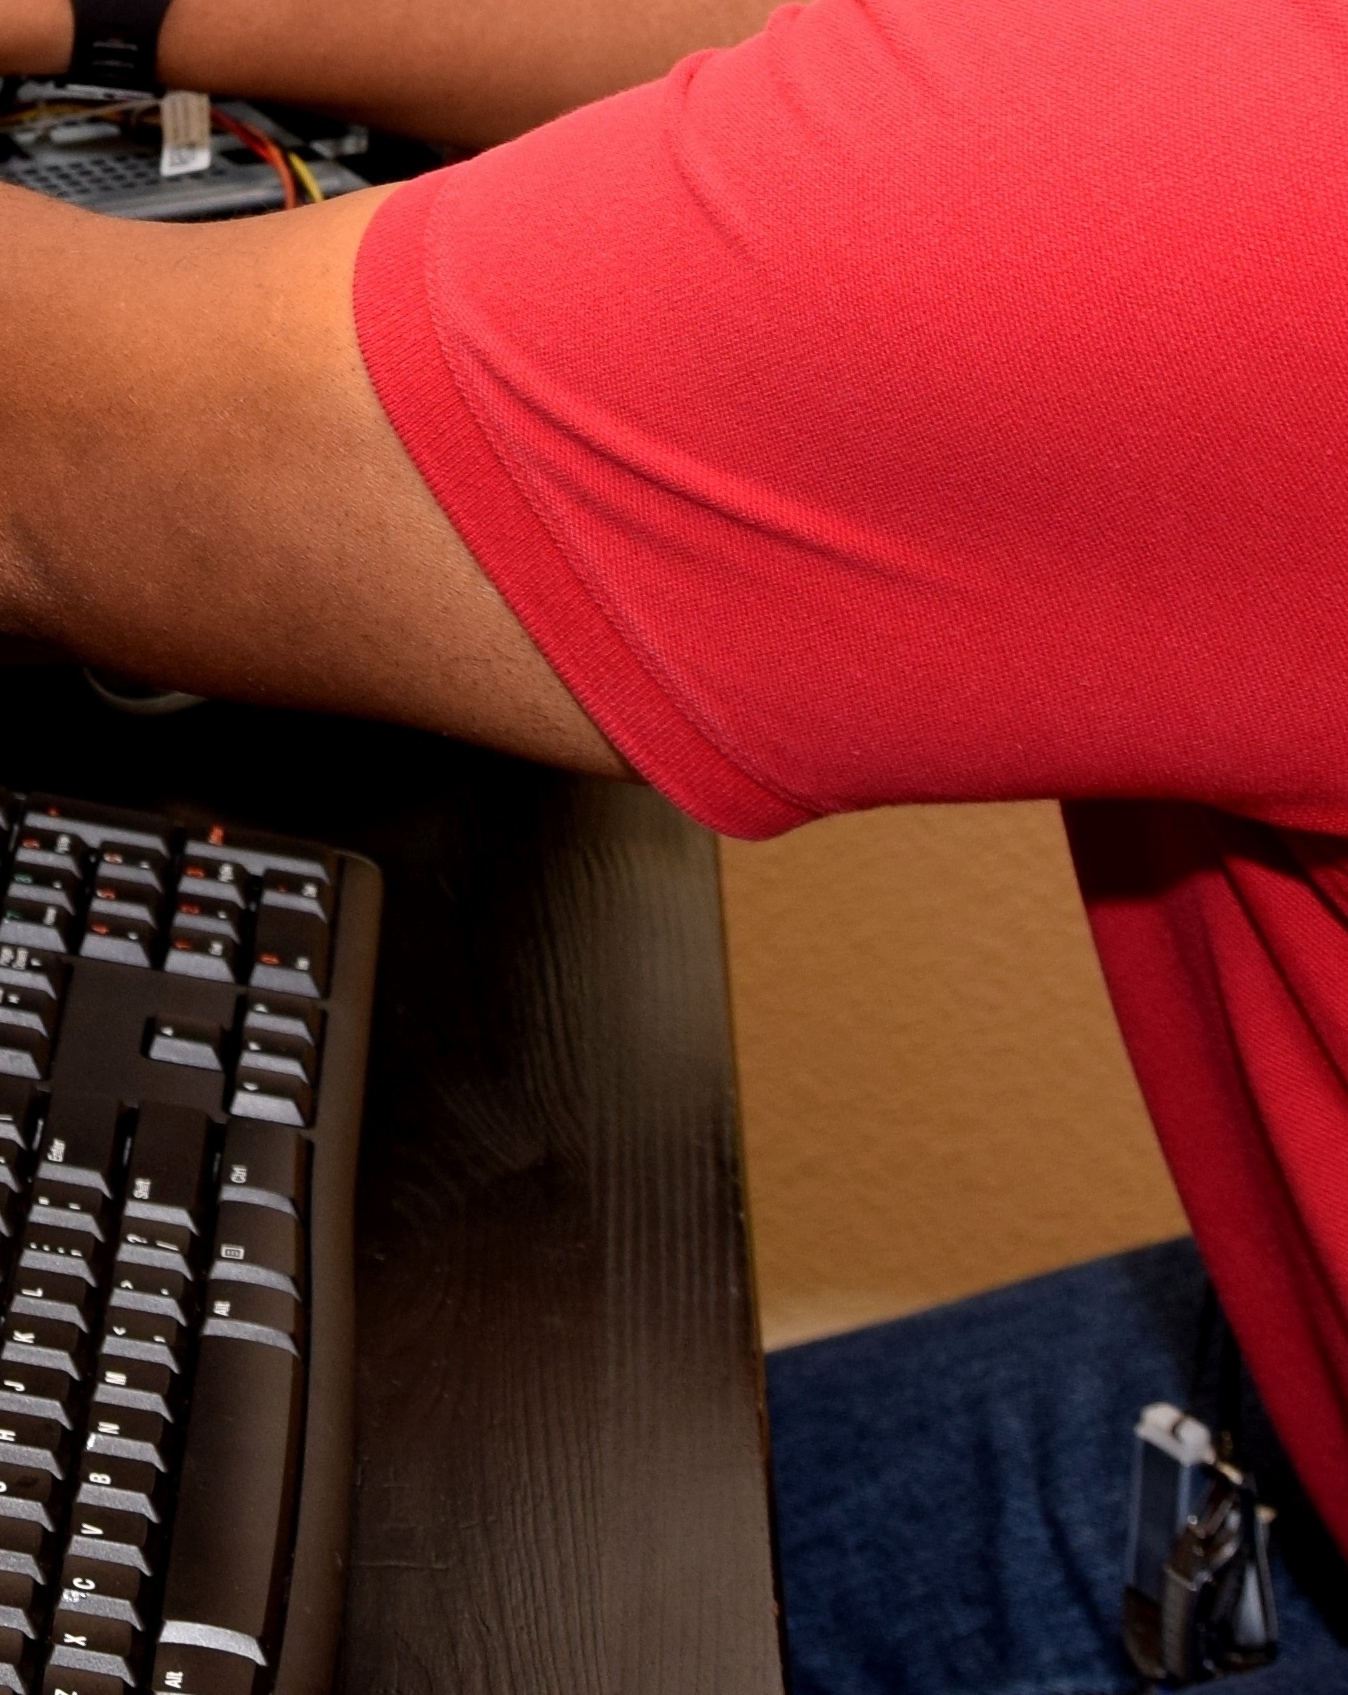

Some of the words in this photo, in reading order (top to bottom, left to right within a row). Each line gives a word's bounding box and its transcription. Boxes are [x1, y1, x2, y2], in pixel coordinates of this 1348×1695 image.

[48, 1139, 65, 1162] Enter
[231, 1166, 246, 1183] Ctrl
[134, 1179, 151, 1199] Shift
[22, 1288, 43, 1297] L
[214, 1301, 230, 1315] Alt
[13, 1331, 35, 1343] K
[105, 1372, 126, 1385] M
[4, 1380, 25, 1391] J
[98, 1422, 119, 1434] N
[89, 1473, 111, 1484] B
[82, 1524, 103, 1534] V
[73, 1578, 95, 1589] C
[64, 1634, 87, 1646] X
[165, 1672, 183, 1688] Alt
